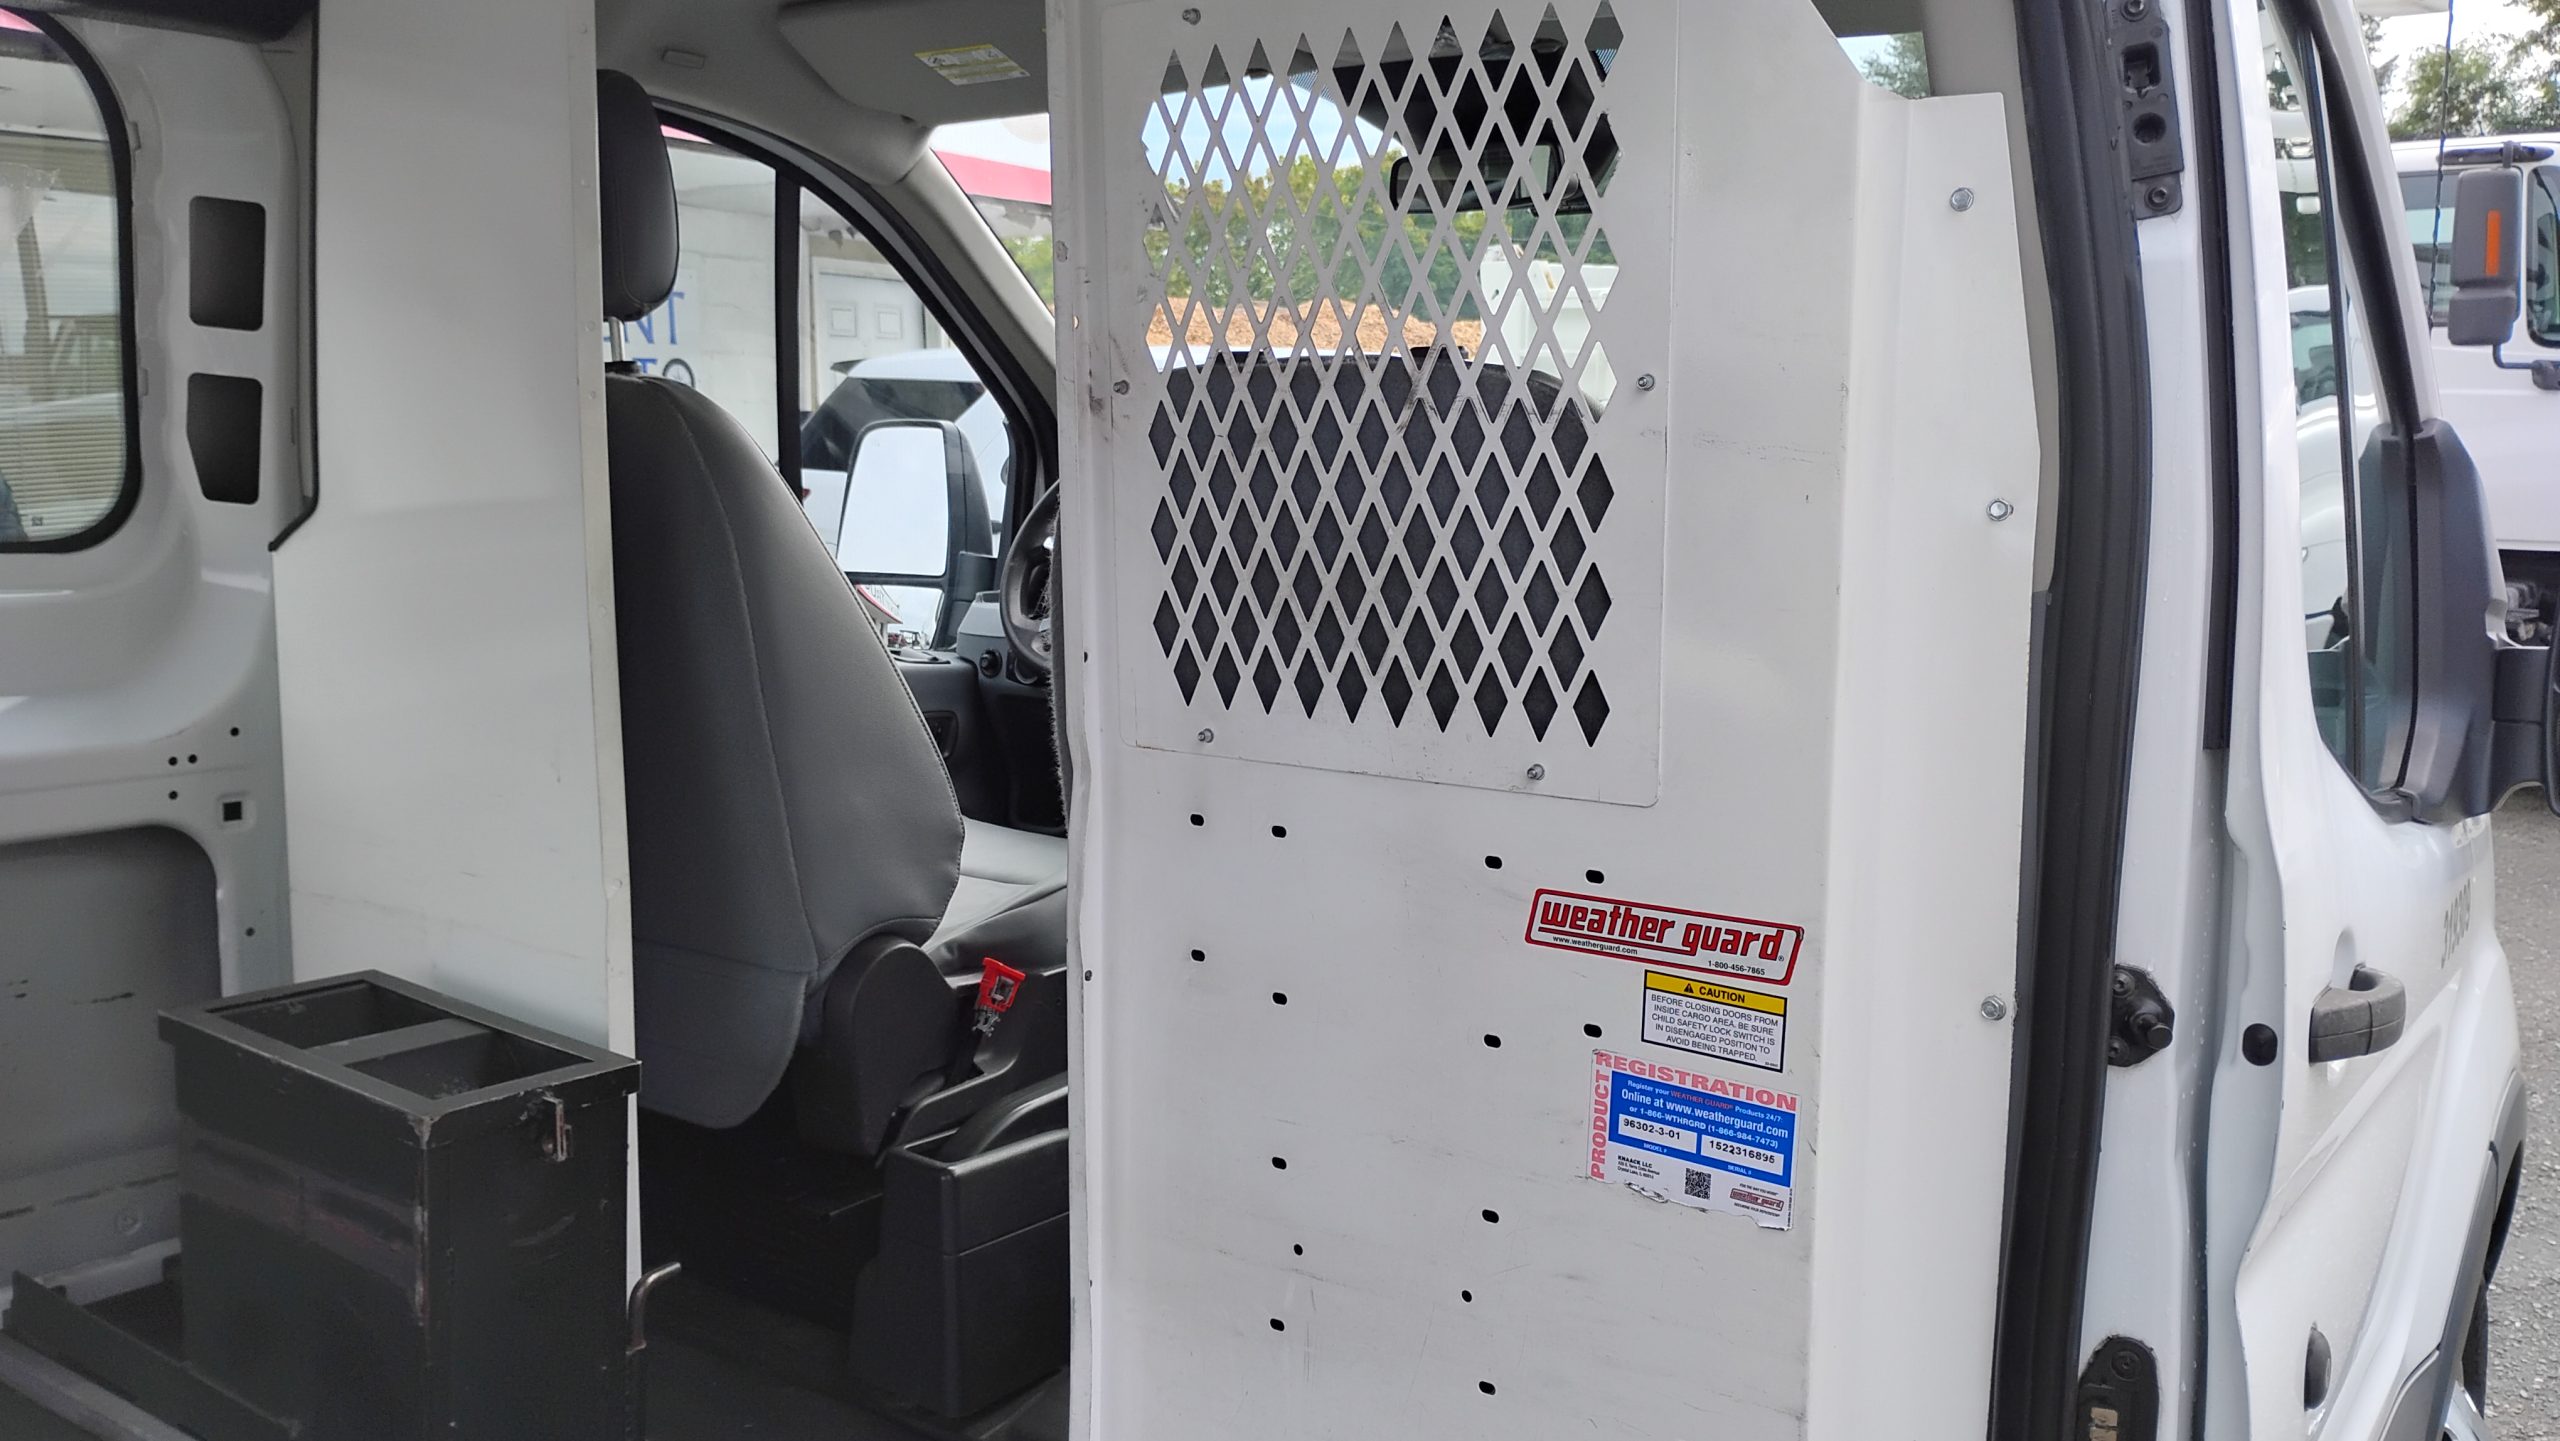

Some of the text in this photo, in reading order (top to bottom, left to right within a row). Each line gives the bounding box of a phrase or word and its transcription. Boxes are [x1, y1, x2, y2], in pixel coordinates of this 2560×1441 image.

[1541, 902, 1676, 944] weather
[1552, 936, 1638, 956] www.weatherguard.com
[1707, 961, 1766, 976] 1-800-456-7865
[1652, 994, 1778, 1028] BEFORE CLOSING DOORS FROM
[1699, 986, 1745, 1004] CAUTION
[1652, 1013, 1775, 1046] CHILD SAFETY LOCK SWITCH IS
[1654, 1004, 1680, 1016] INSIDE
[1682, 1010, 1710, 1023] CARGO
[1738, 1022, 1749, 1031] BE
[1751, 1025, 1774, 1036] SURE
[1656, 1023, 1770, 1055] IN DISENGAGED POSITION TO
[1666, 1035, 1758, 1062] AVOID BEING TRAPPED.
[1597, 1053, 1796, 1111] REGISTRATION
[1622, 1089, 1788, 1139] Online at www.weatherguard.com
[1628, 1080, 1653, 1092] Register
[1656, 1088, 1669, 1096] your
[1671, 1091, 1703, 1104] WEATHER
[1735, 1106, 1765, 1119] Products
[1592, 1070, 1609, 1179] PRODUCT
[1624, 1118, 1680, 1140] 96302-3-01
[1640, 1108, 1706, 1130] 1-866-WTHRGRD
[1708, 1125, 1778, 1149] (1-866-984-7473)
[1618, 1155, 1640, 1165] KNAACK
[1644, 1143, 1662, 1152] MODEL
[1710, 1140, 1775, 1164] 1522316895
[1728, 1165, 1747, 1174] SERIAL
